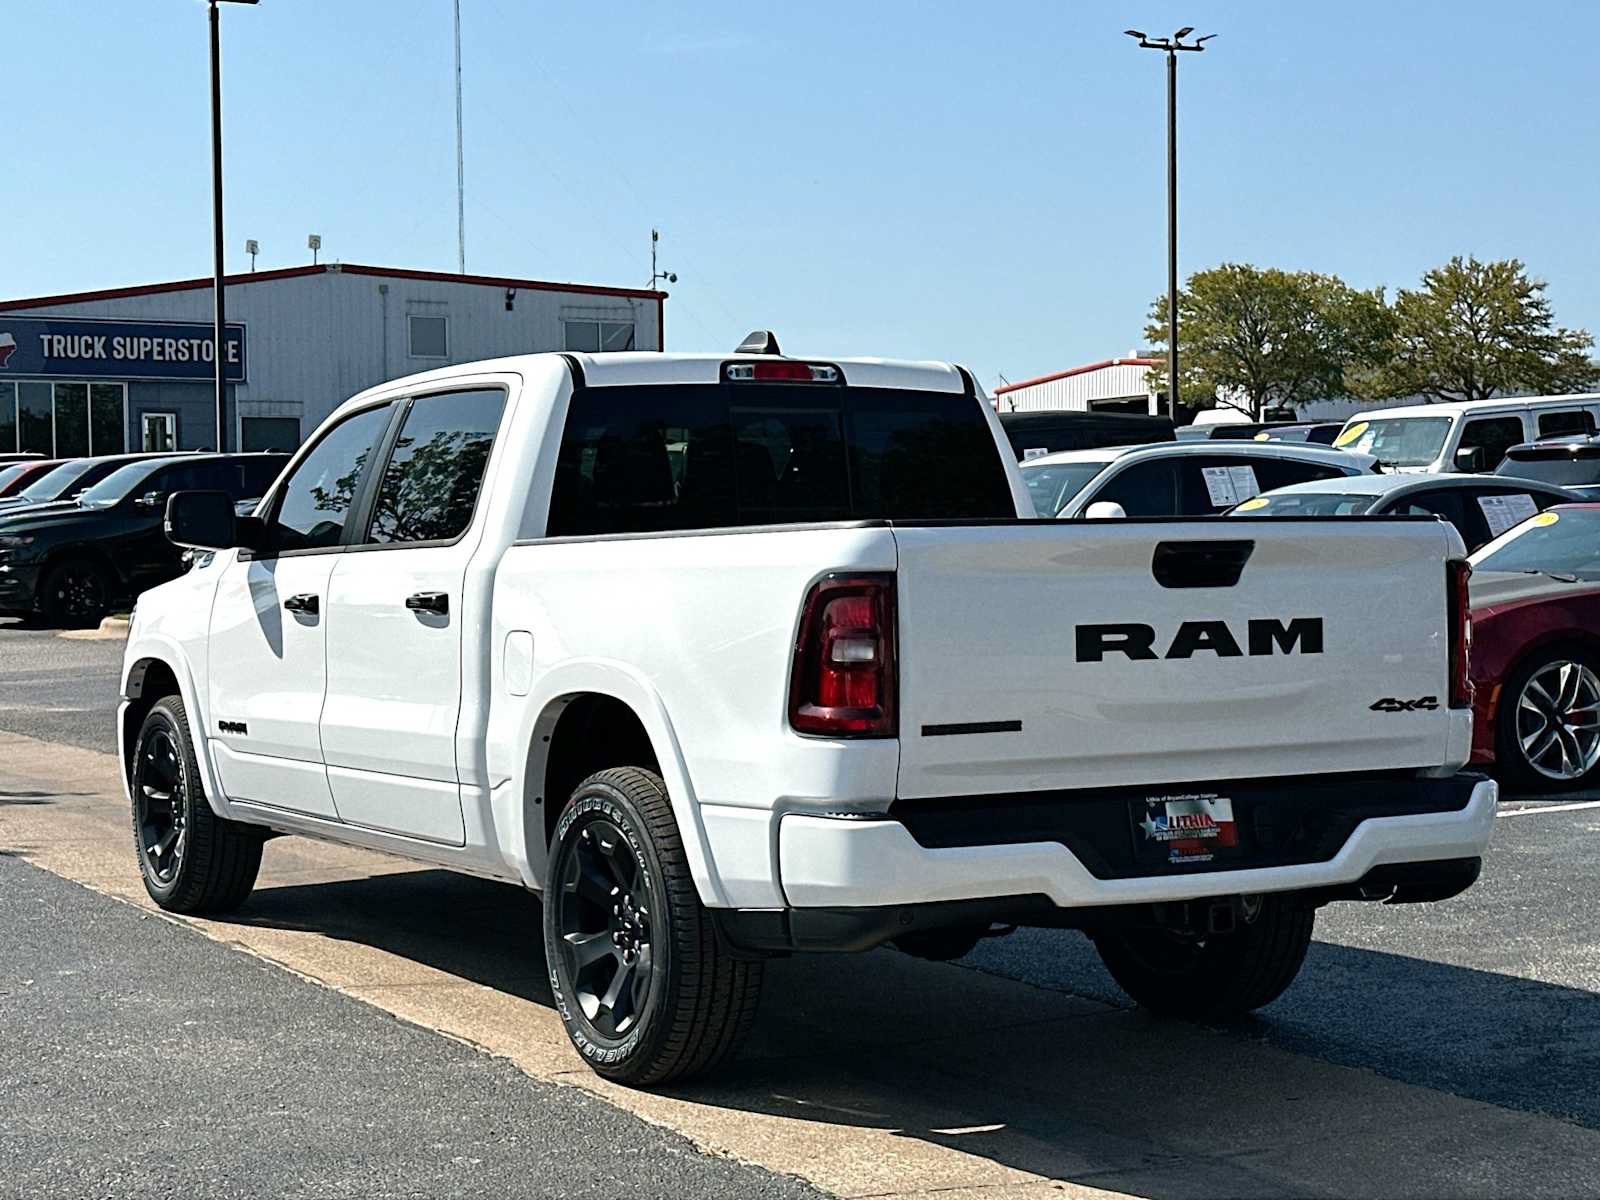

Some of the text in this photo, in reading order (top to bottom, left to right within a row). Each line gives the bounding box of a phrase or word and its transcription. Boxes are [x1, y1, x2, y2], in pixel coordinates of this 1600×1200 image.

[39, 334, 239, 363] TRUCK SUPERSTOE
[1075, 617, 1324, 662] RAM
